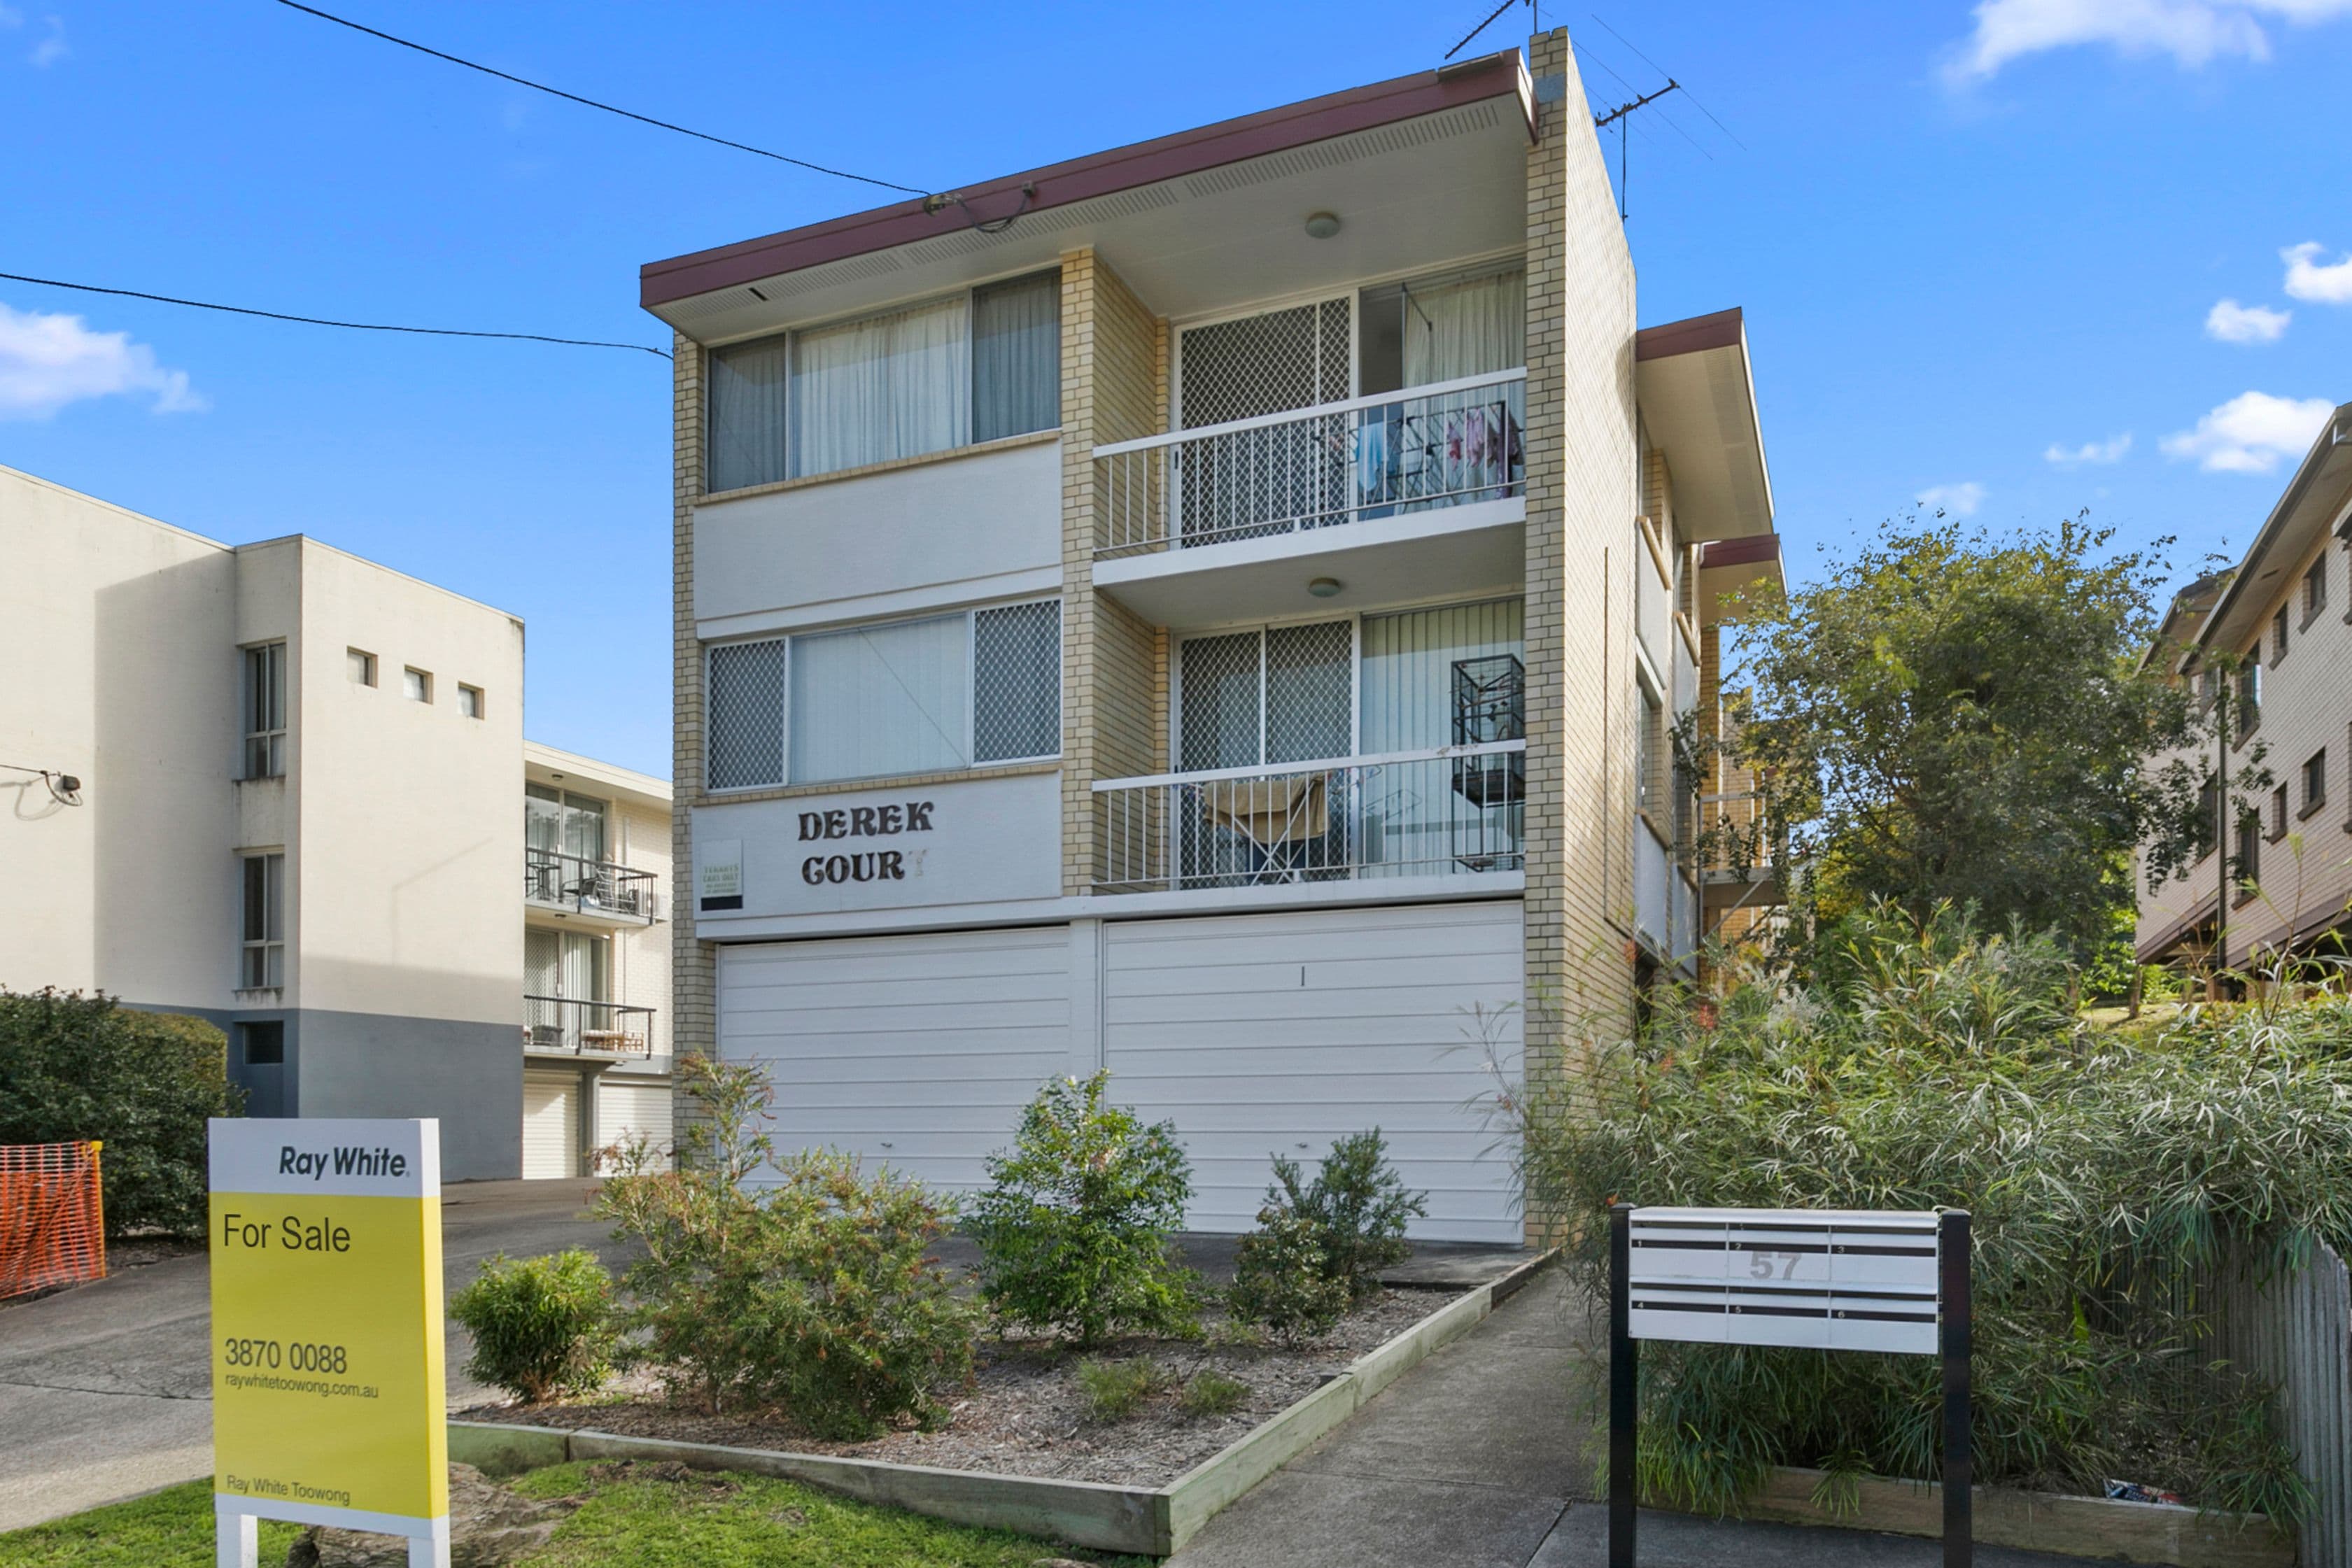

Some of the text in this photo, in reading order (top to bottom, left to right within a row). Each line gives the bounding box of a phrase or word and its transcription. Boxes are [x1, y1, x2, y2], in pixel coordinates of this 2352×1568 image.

[798, 801, 934, 841] DEREK
[279, 1146, 406, 1181] Ray White
[224, 1214, 351, 1252] For Sale
[1750, 1251, 1802, 1280] 57
[225, 1338, 348, 1374] 3870 0088
[225, 1373, 379, 1399] raywhitetoowong.com.au
[226, 1475, 350, 1506] Ray White Toowong
